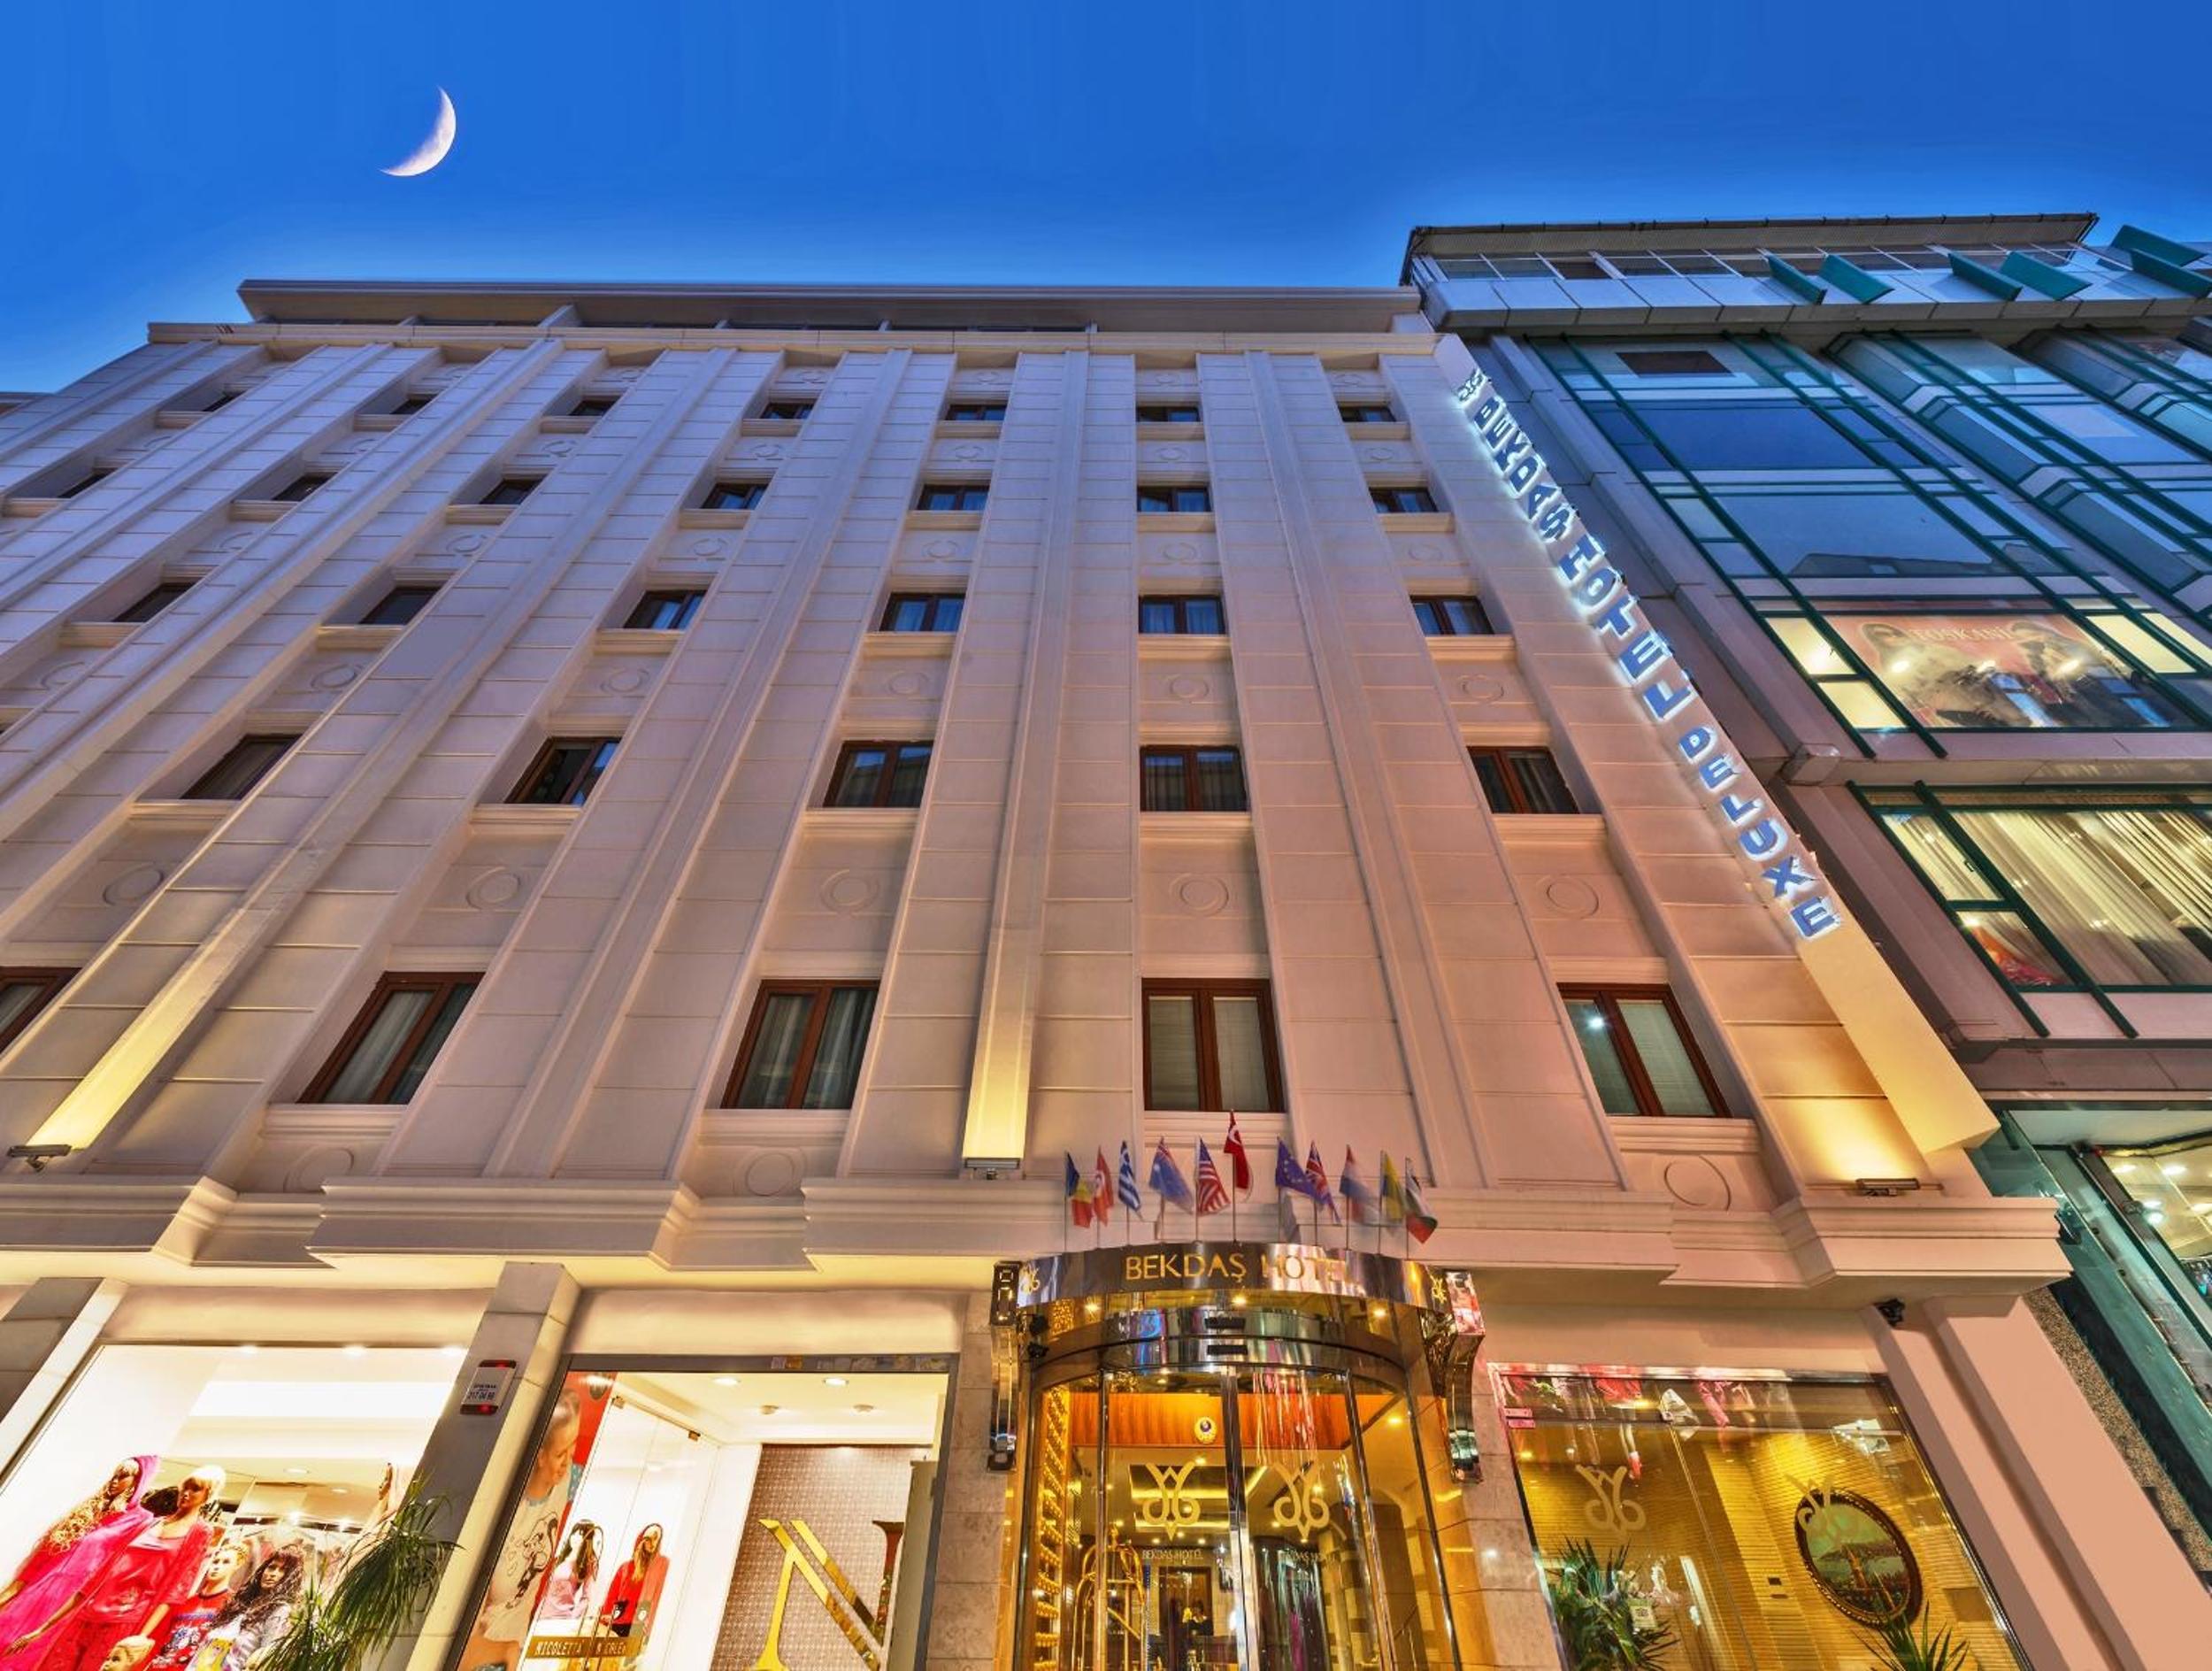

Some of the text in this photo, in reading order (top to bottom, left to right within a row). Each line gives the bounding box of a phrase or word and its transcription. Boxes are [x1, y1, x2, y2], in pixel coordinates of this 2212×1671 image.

[1558, 533, 1694, 720] HOTEL
[1679, 727, 1841, 939] DELUXE
[1125, 1252, 1247, 1282] BEKDAŞ
